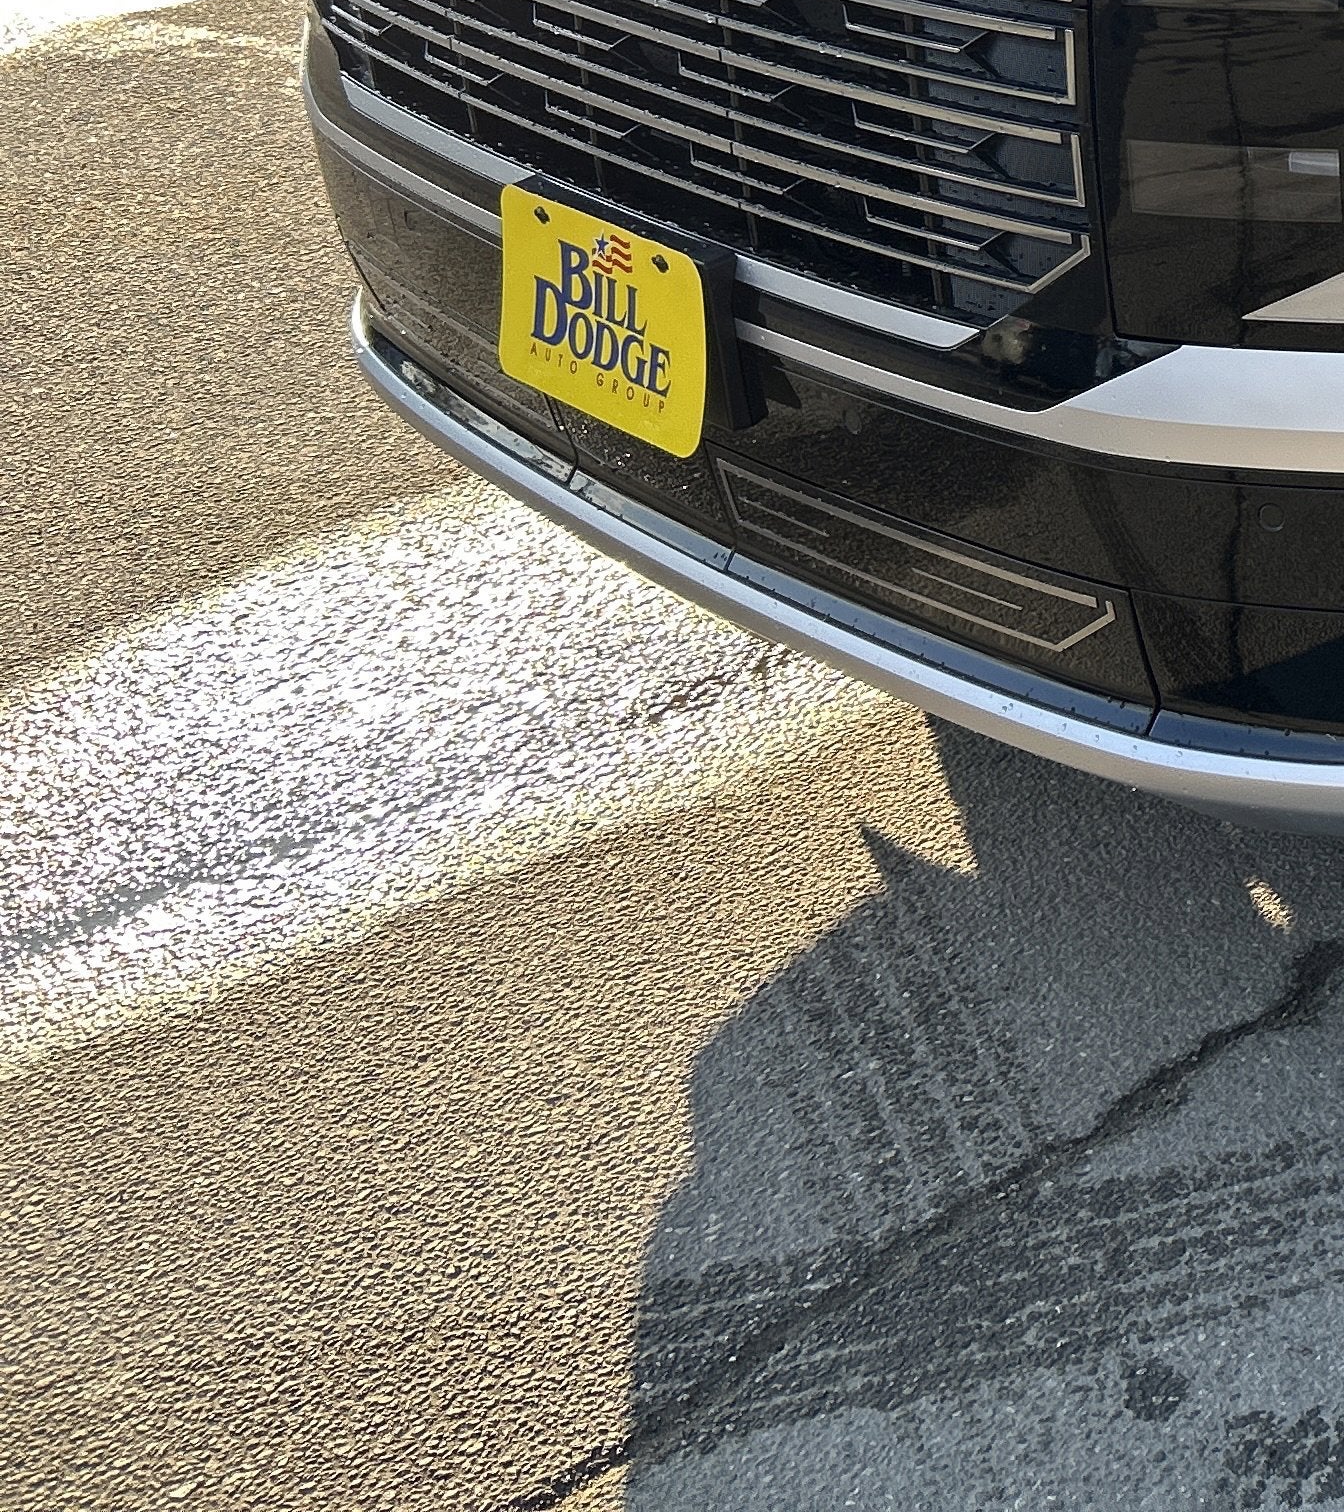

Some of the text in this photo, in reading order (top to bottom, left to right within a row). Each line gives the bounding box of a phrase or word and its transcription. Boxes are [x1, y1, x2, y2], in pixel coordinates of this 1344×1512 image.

[558, 238, 647, 335] BILL
[529, 342, 666, 414] AUTO GROUP
[530, 274, 672, 398] DODGE
